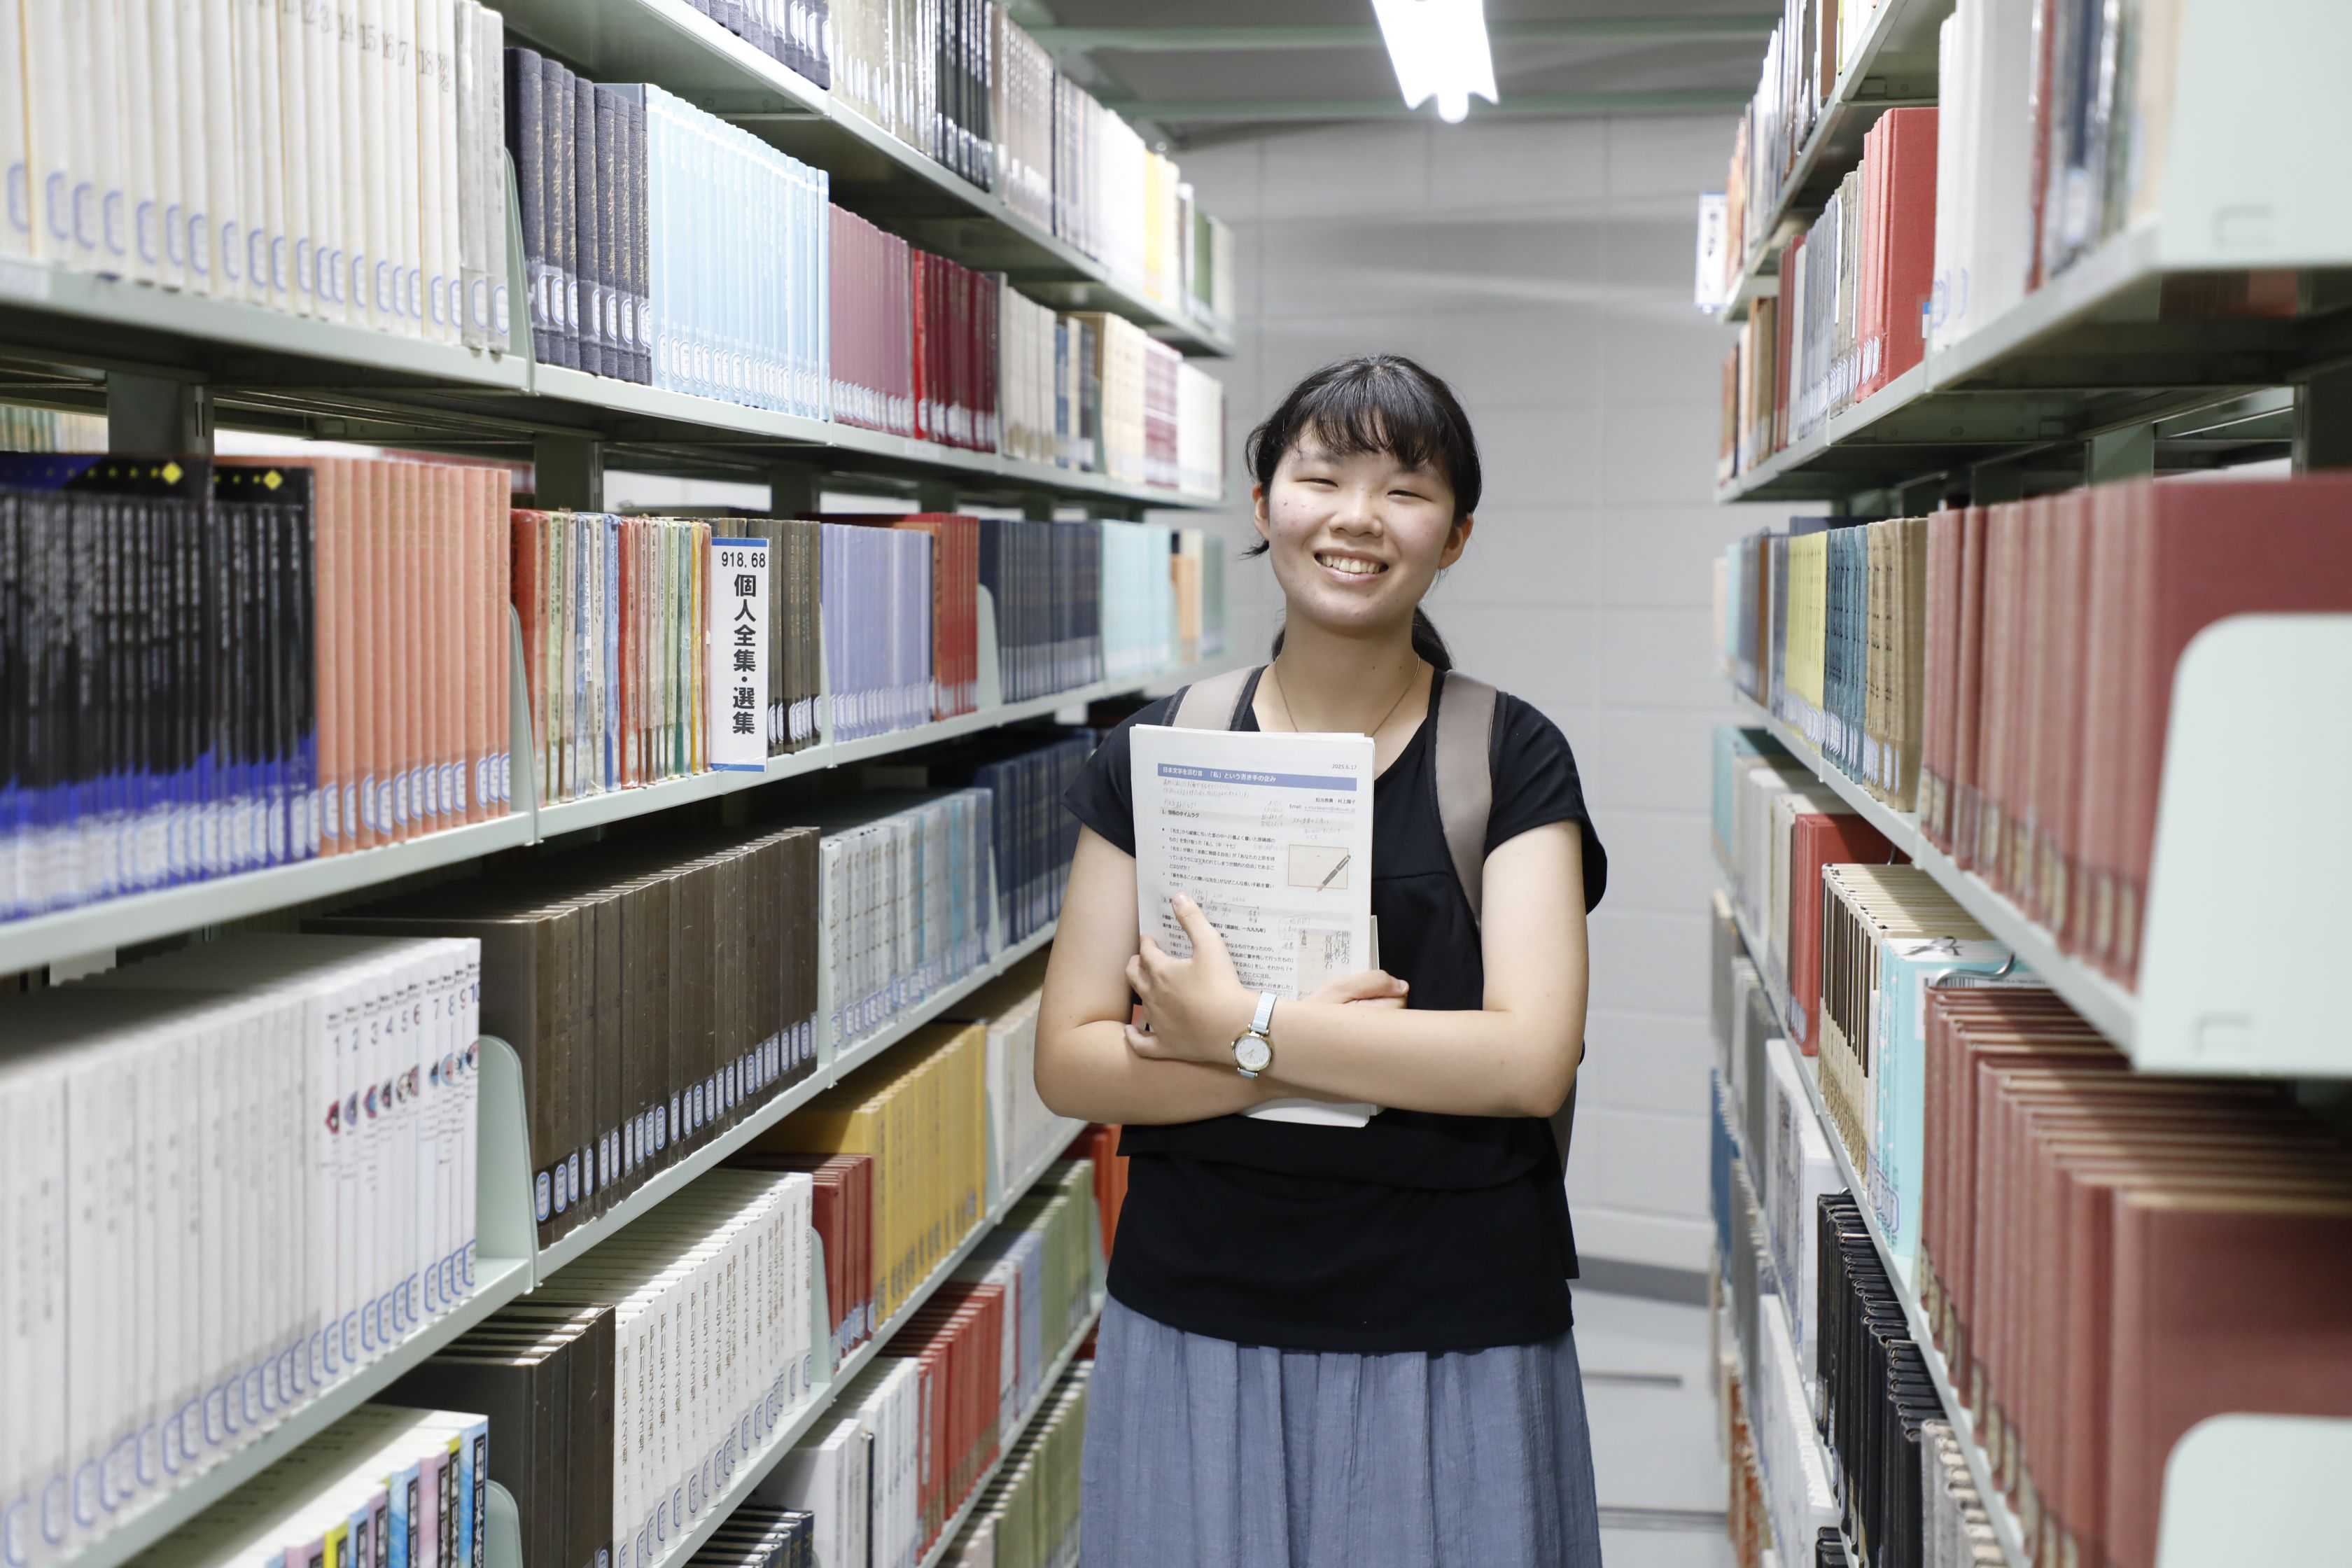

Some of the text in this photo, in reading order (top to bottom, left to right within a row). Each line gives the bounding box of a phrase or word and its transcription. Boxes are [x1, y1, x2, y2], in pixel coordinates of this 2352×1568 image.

[340, 14, 354, 43] 14
[359, 24, 377, 52] 15
[382, 32, 396, 59] 16
[419, 50, 433, 75] 18
[438, 53, 450, 92] 別巻
[722, 551, 766, 568] 918.68
[732, 573, 757, 736] 個人全集・選集
[459, 988, 467, 1010] 9
[469, 981, 480, 1004] 10
[413, 1003, 420, 1026] 6
[433, 998, 440, 1021] 7
[448, 994, 455, 1016] 8
[370, 1021, 378, 1045] 3
[386, 1015, 393, 1036] 4
[401, 1010, 407, 1032] 5
[352, 1027, 359, 1051] 2
[473, 1438, 484, 1568] [新編]日本女性
